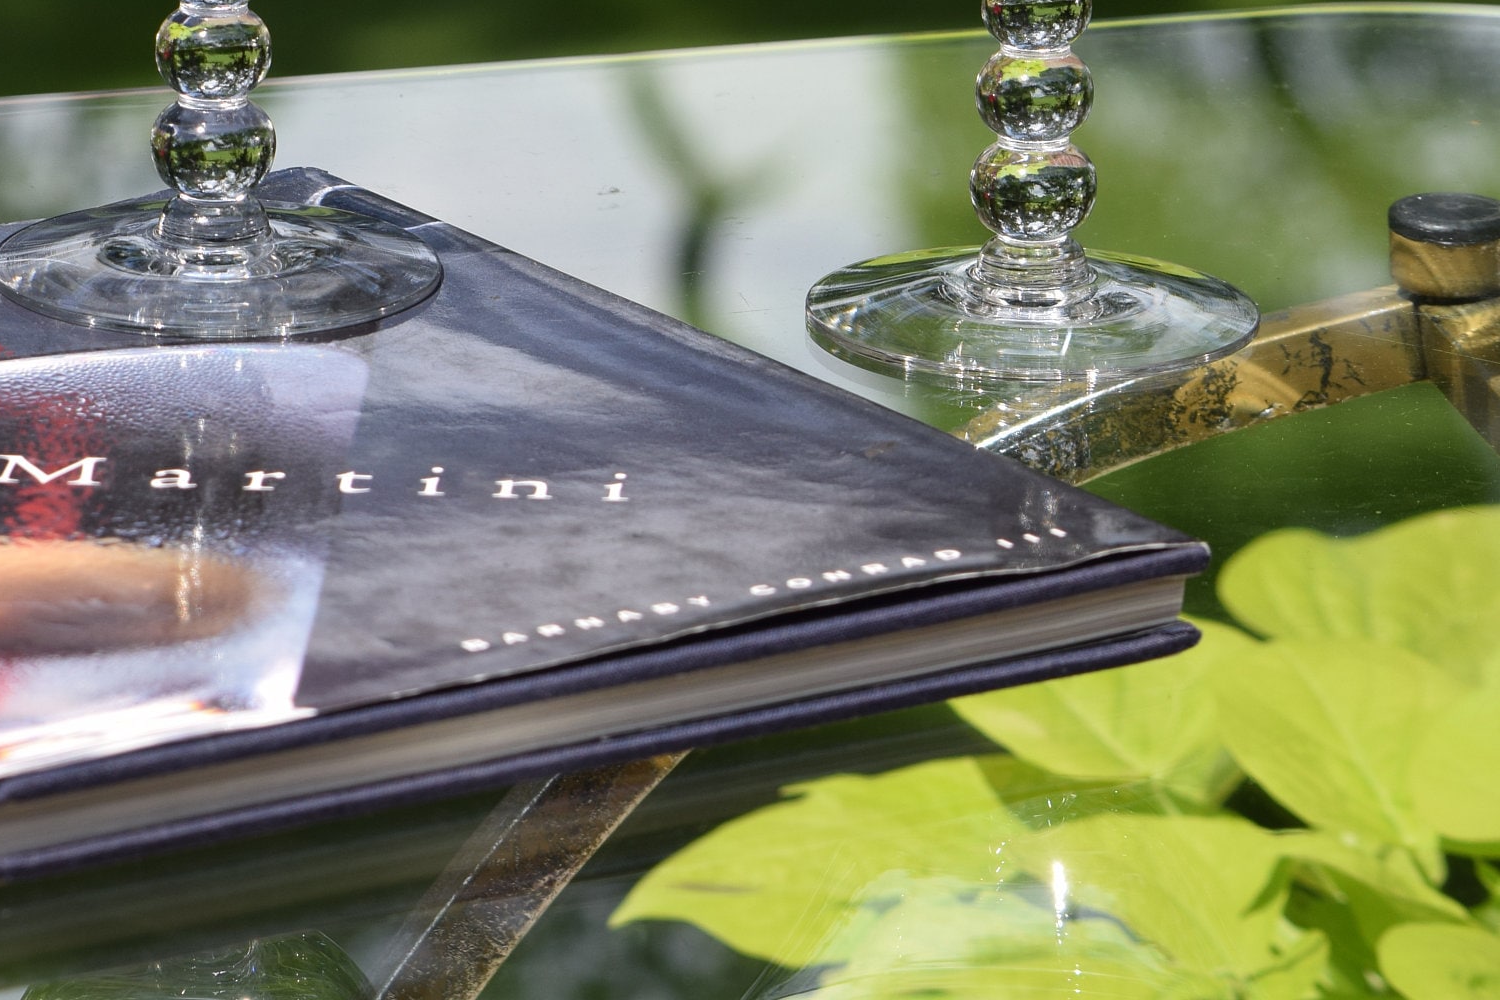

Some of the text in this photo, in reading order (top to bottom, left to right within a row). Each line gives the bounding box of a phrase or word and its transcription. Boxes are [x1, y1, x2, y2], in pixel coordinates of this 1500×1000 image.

[460, 527, 1067, 653] BARNABY CONRAD III
